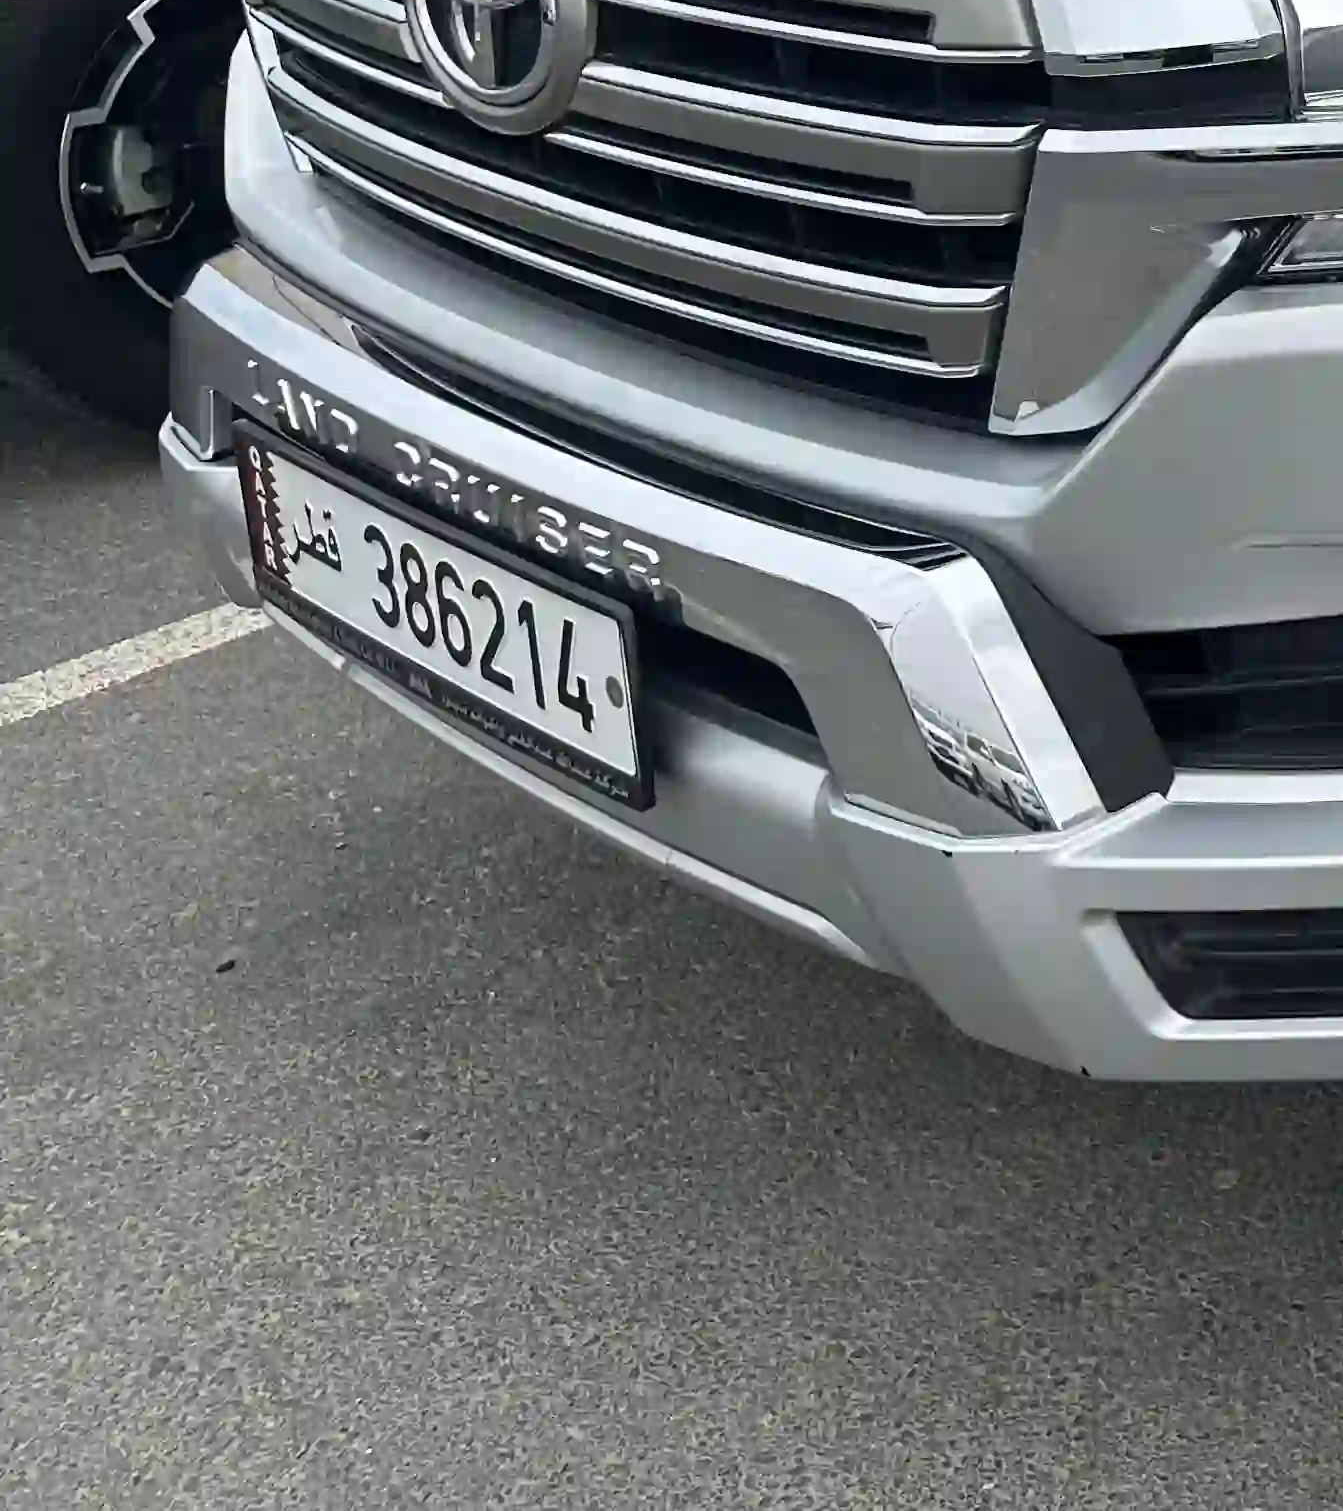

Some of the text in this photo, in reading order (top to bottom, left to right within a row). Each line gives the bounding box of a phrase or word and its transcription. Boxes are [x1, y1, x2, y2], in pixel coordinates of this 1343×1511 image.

[249, 445, 278, 571] QATAR
[290, 500, 342, 573] قطر
[393, 440, 661, 589] CRUISER
[363, 521, 595, 734] 386214
